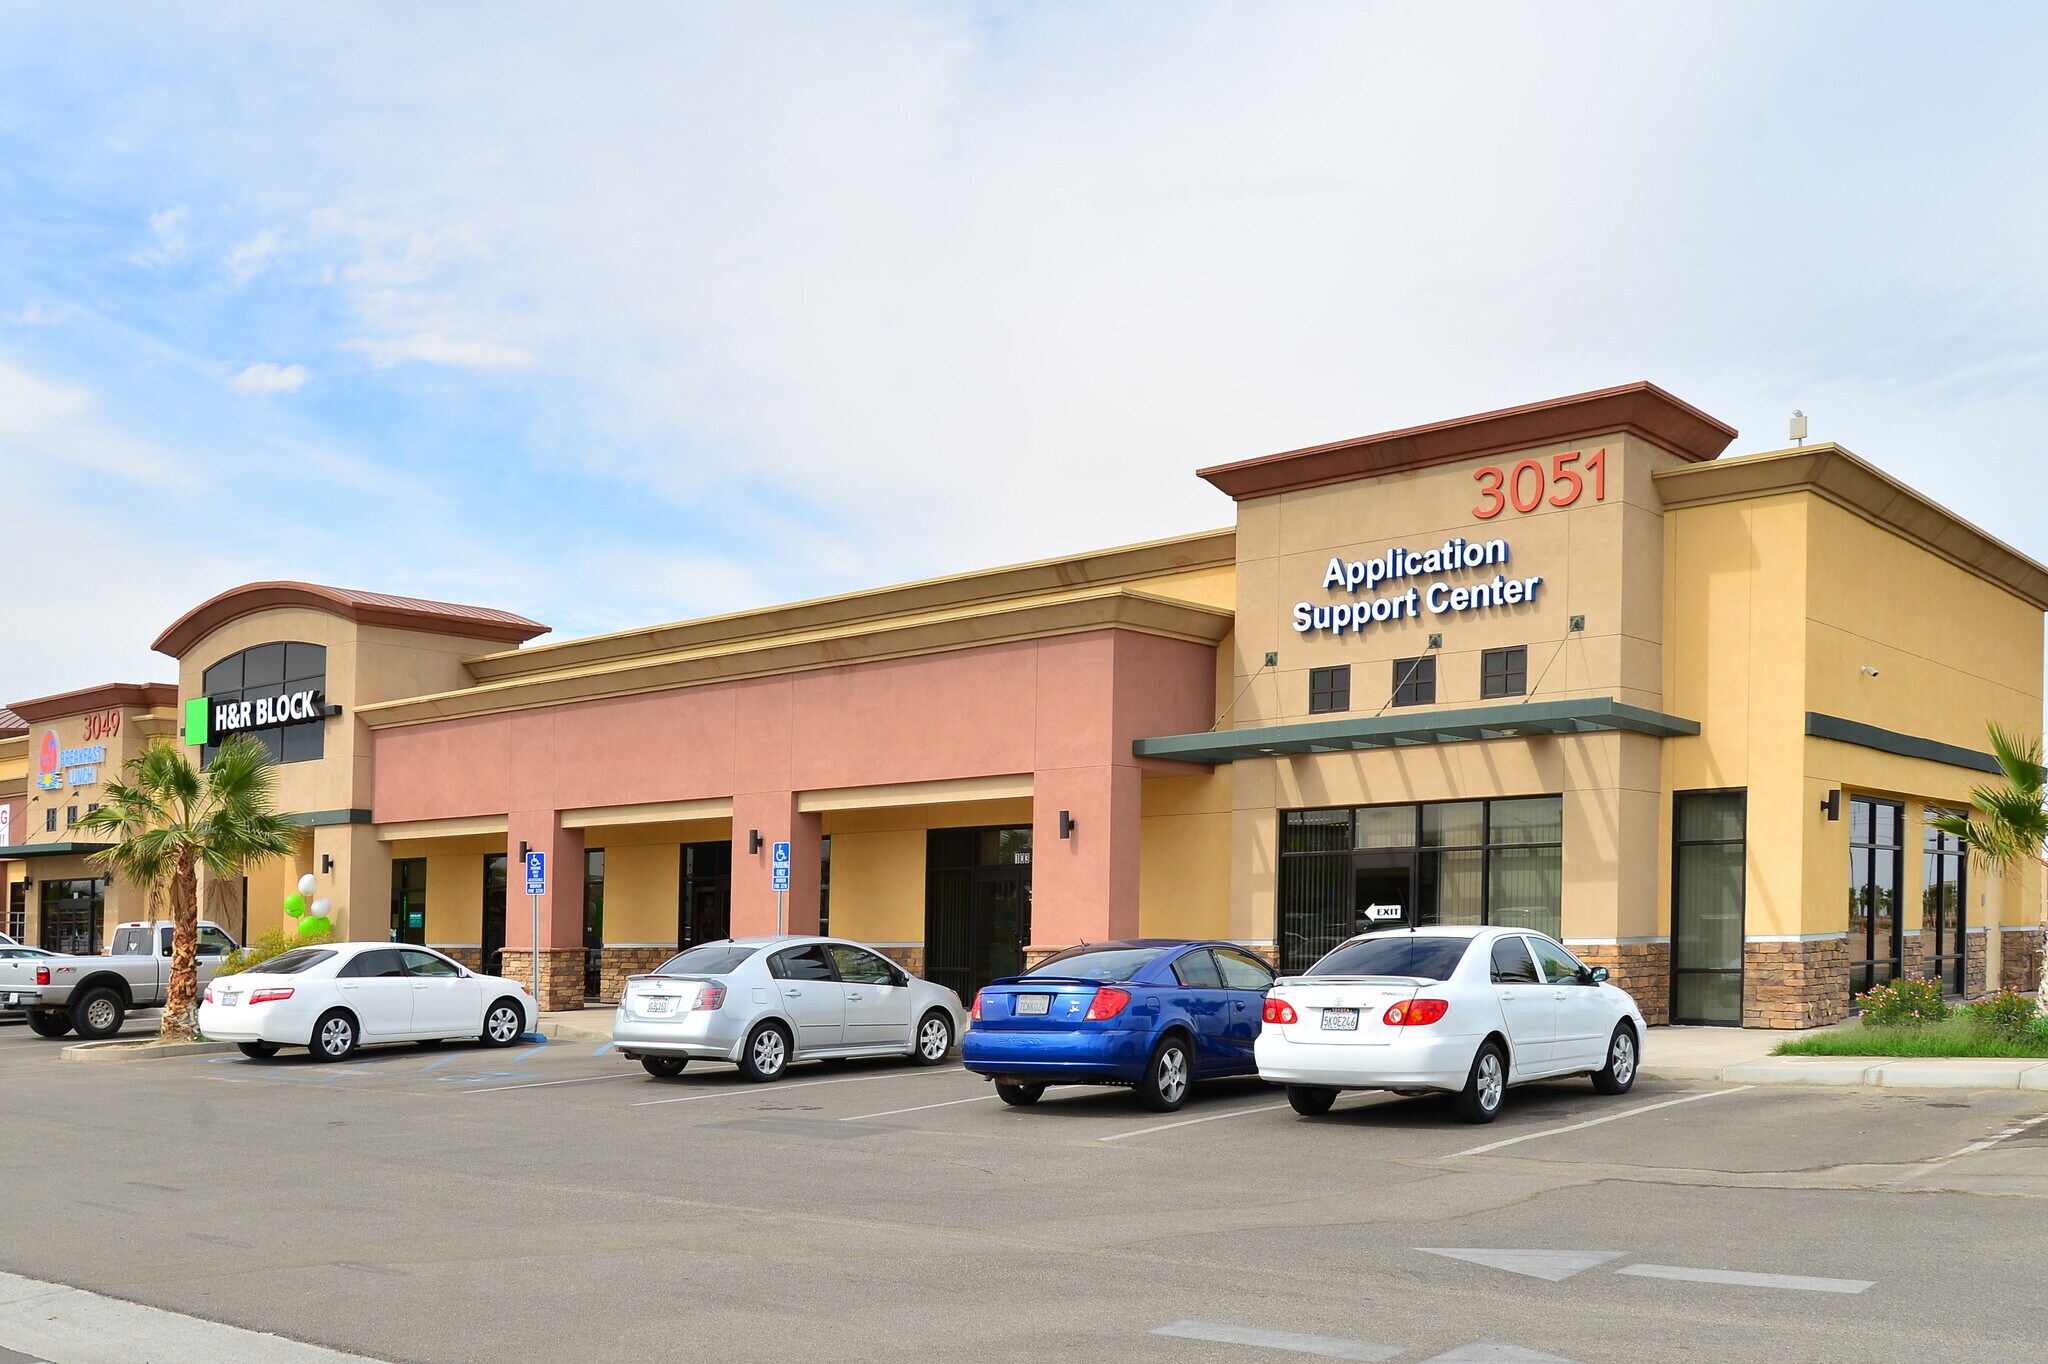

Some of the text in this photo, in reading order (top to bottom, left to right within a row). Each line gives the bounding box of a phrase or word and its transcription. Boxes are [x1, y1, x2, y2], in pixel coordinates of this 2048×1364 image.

[1471, 447, 1605, 519] 3051
[1321, 537, 1510, 593] Application
[1291, 574, 1544, 635] Support Center
[82, 709, 121, 742] 3049
[215, 689, 316, 731] H&R BLOCK
[60, 745, 105, 768] BREAKFAST
[67, 767, 97, 787] LUNCH
[1014, 852, 1030, 865] 103
[1377, 908, 1399, 916] EXIT
